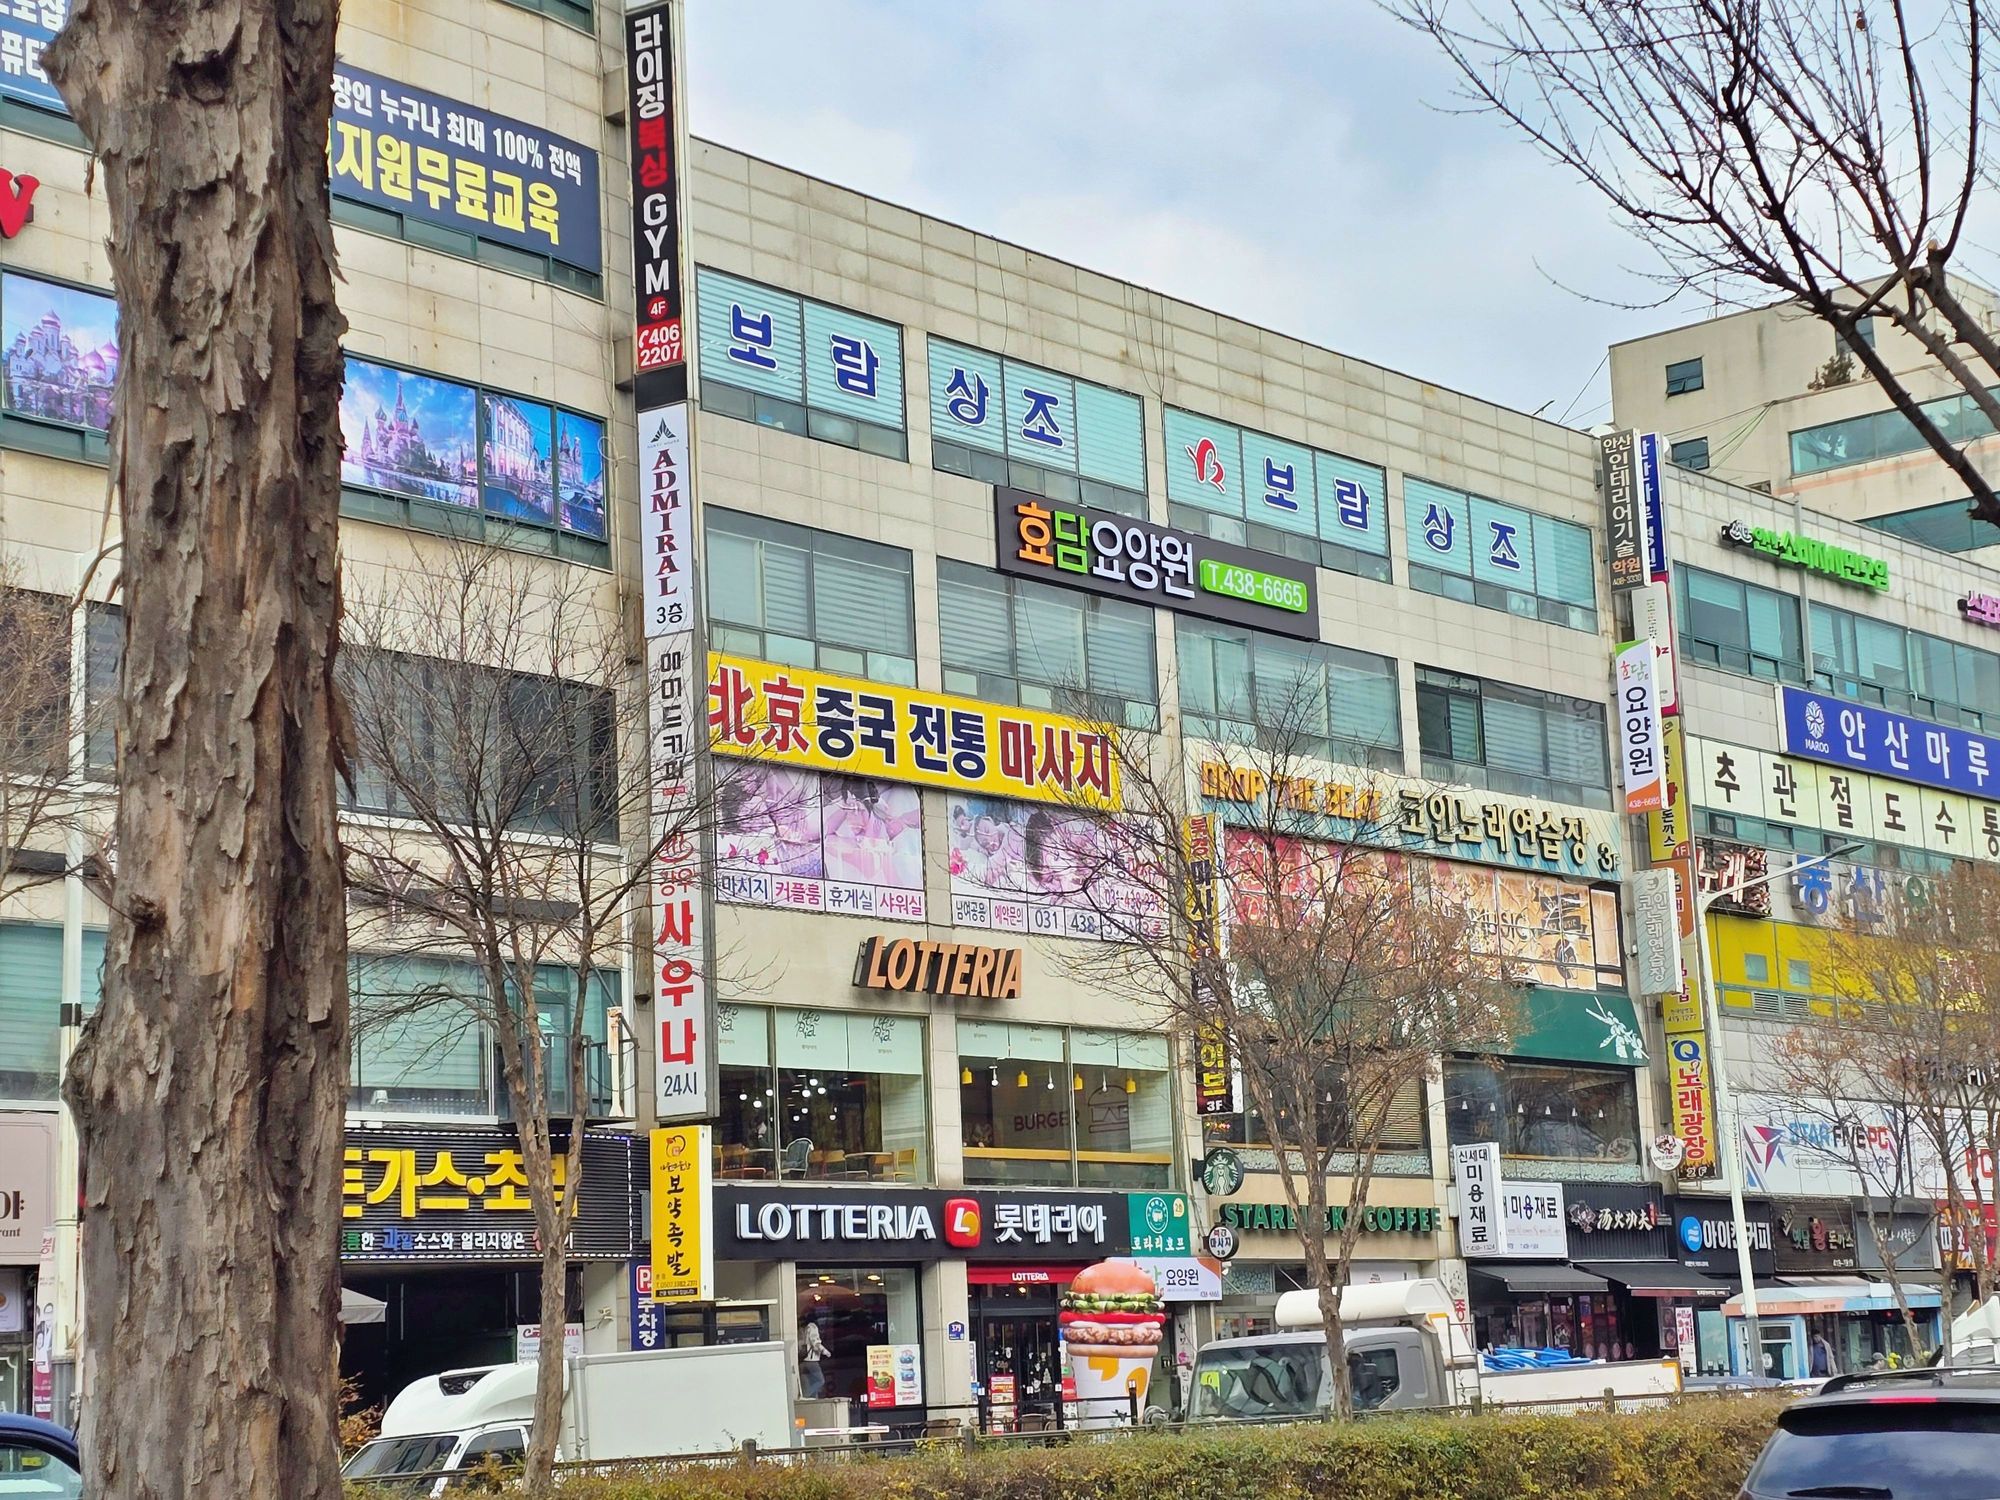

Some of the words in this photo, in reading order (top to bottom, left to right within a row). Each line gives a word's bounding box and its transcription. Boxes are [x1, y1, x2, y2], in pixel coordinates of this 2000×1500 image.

[380, 89, 441, 139] 누구나
[446, 110, 485, 152] 최대
[492, 127, 543, 170] 100%
[548, 144, 582, 186] 전액
[643, 193, 670, 295] GYM
[650, 301, 666, 315] 4F
[649, 324, 680, 345] 406
[640, 342, 681, 367] 2207
[1603, 434, 1631, 453] 안산
[650, 448, 682, 598] ADMIRAL
[1612, 558, 1641, 575] 학원
[656, 602, 683, 624] 3층
[708, 667, 811, 753] 北京
[816, 686, 896, 765] 중국
[909, 703, 986, 779] 전통
[1001, 720, 1112, 798] 마사지
[1625, 686, 1654, 776] 요양원
[1202, 760, 1264, 804] DROP
[1599, 842, 1621, 871] 3F
[775, 882, 821, 905] 커플룸
[829, 886, 873, 911] 휴게실
[1035, 909, 1058, 929] 031
[862, 935, 1022, 999] LOTTERIA
[658, 900, 697, 1065] 사우나
[664, 1072, 697, 1097] 24시
[1206, 1101, 1222, 1111] 3F
[1459, 1148, 1488, 1163] 신세대
[1687, 1167, 1706, 1177] 2F
[1466, 1164, 1488, 1243] 미용재료
[667, 1175, 690, 1276] 보약족발
[736, 1202, 937, 1241] LOTTERIA
[994, 1203, 1107, 1245] 롯데리아
[1364, 1206, 1442, 1232] COFFEE
[461, 1230, 525, 1251] 얼리지않은
[1012, 1271, 1049, 1282] LOTTERIA
[1166, 1269, 1199, 1286] 요양원
